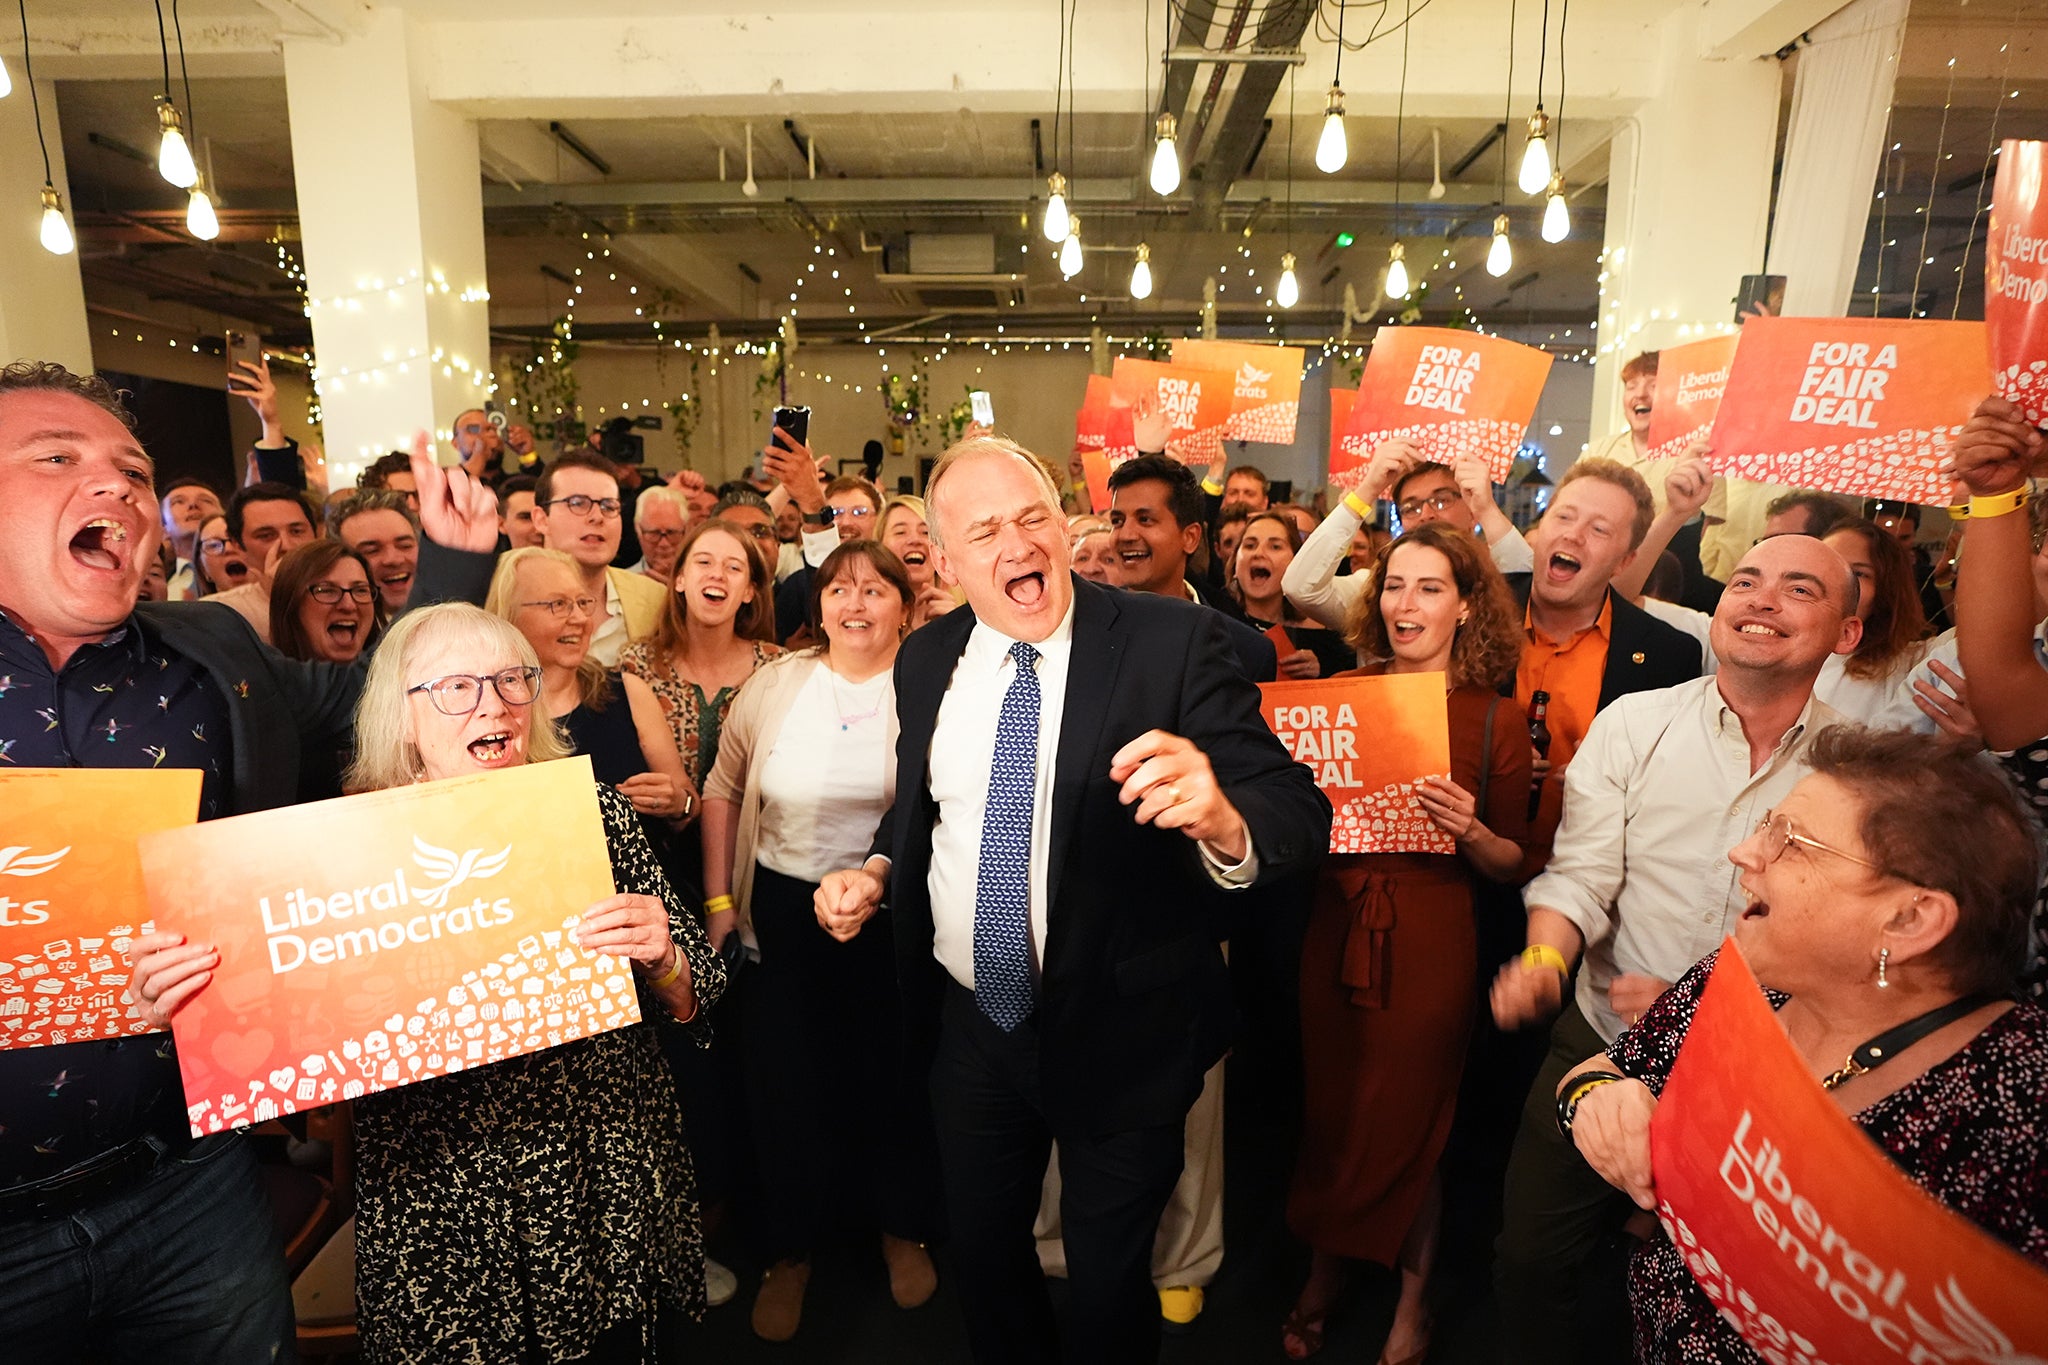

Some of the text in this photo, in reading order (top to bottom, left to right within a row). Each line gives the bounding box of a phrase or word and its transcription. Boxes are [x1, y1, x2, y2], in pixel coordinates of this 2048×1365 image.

[1419, 344, 1481, 372] FOR A
[1808, 341, 1898, 370] FOR A
[1157, 377, 1202, 396] FOR A
[1411, 363, 1475, 394] FAIR
[1679, 365, 1727, 390] Liberal
[1799, 366, 1890, 401] FAIR
[1403, 385, 1467, 416] DEAL
[1789, 396, 1881, 430] DEAL
[1274, 703, 1359, 730] FOR A
[1277, 729, 1360, 761] FAIR
[259, 868, 409, 934] Liberal
[267, 897, 514, 974] Democrats
[1733, 1109, 1907, 1309] Liberal
